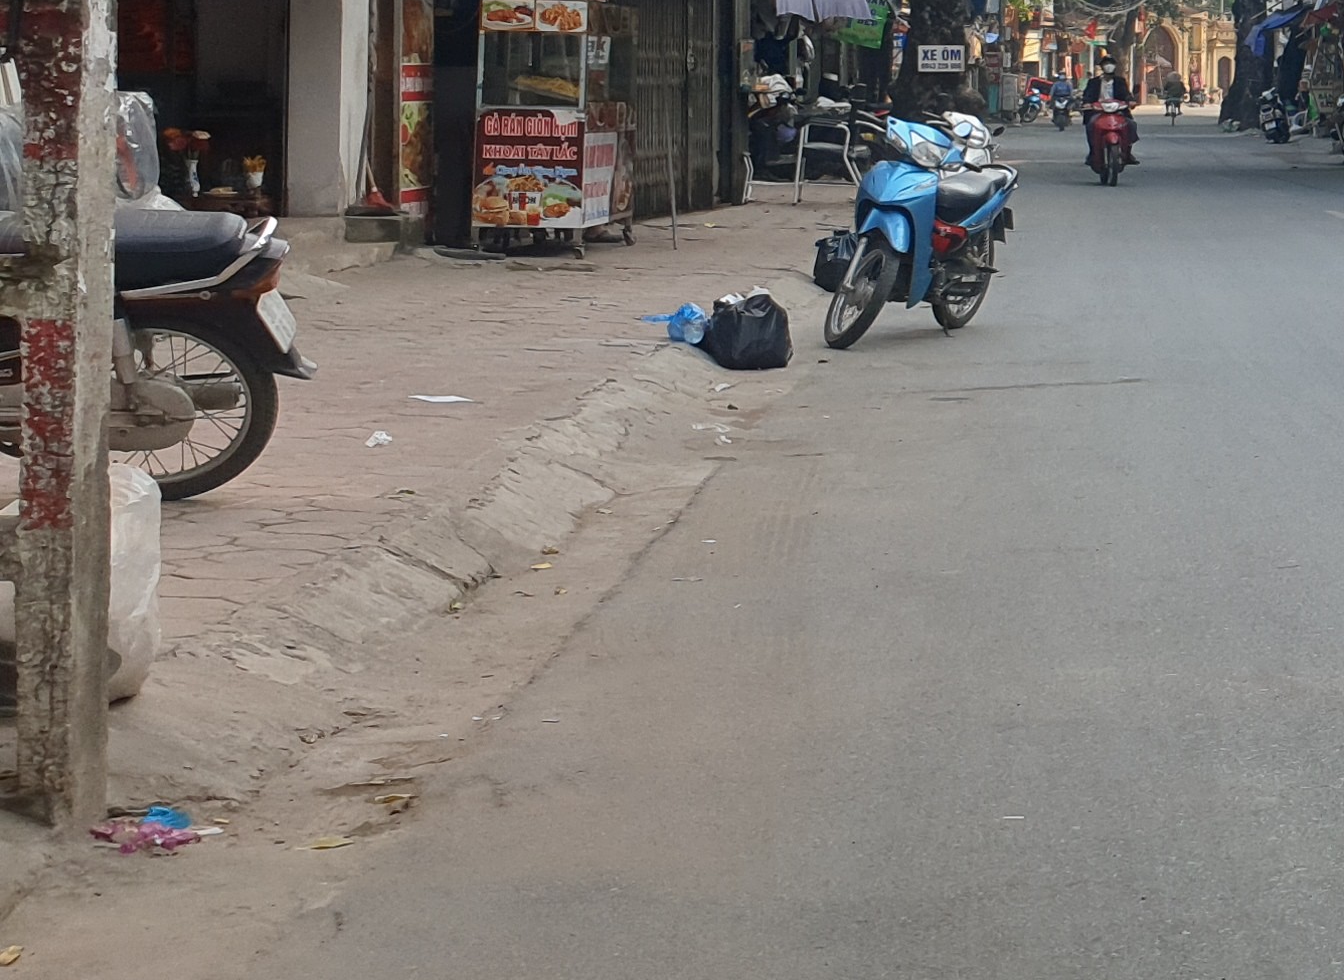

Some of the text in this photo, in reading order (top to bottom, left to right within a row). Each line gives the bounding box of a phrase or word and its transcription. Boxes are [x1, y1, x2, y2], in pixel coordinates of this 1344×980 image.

[922, 47, 961, 61] XE ÔM
[485, 112, 500, 136] GÀ
[501, 113, 525, 137] RÁN
[483, 144, 526, 159] KHOAI
[528, 143, 552, 160] TÂY
[552, 141, 578, 160] LẮC
